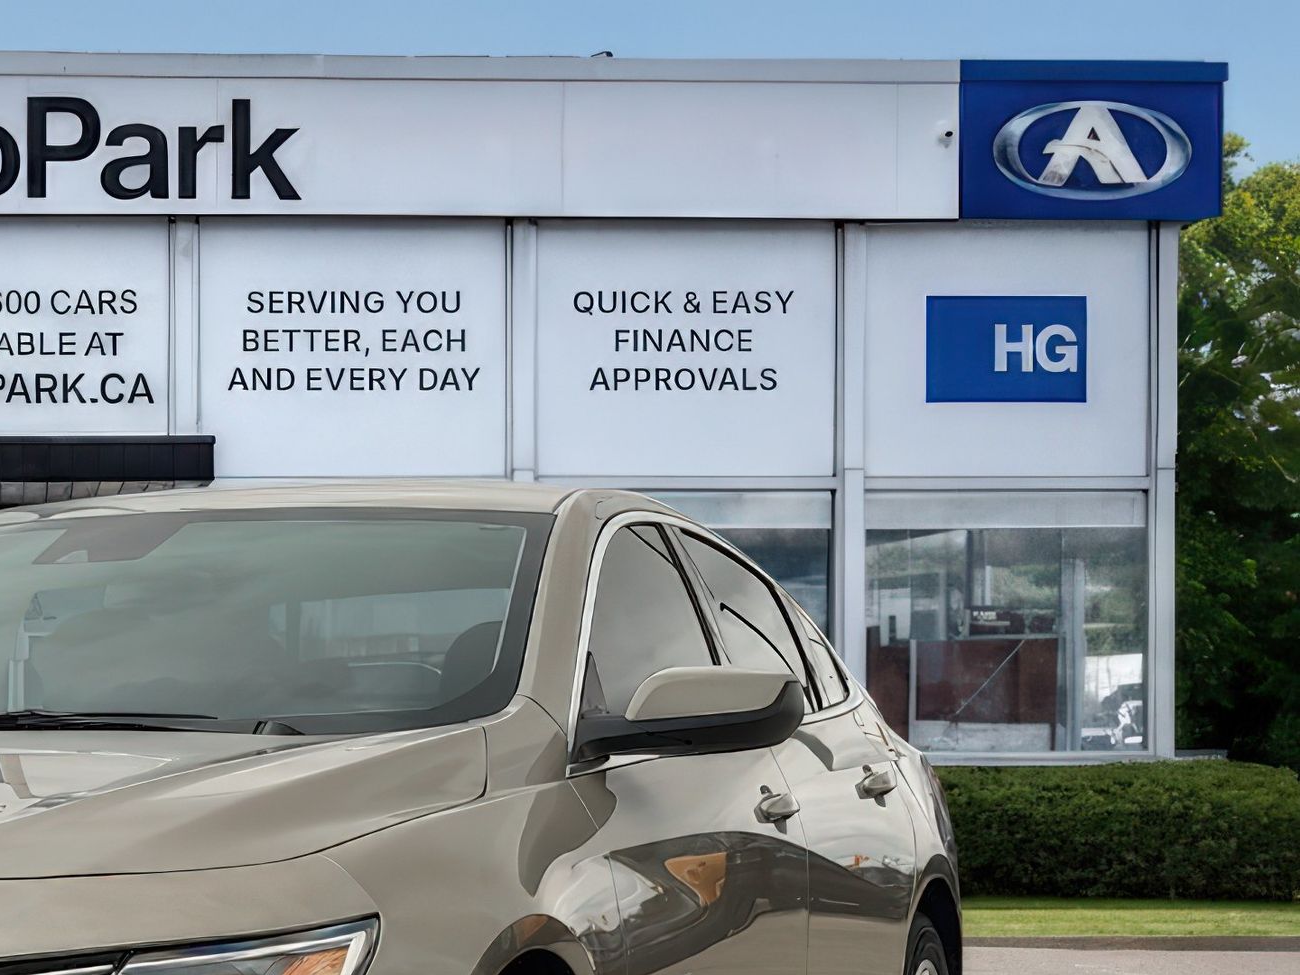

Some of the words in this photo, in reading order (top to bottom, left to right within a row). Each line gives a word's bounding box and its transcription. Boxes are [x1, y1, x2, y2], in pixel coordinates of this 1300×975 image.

[50, 288, 138, 316] CARS
[246, 290, 385, 314] SERVING
[395, 290, 461, 314] YOU
[573, 290, 673, 316] QUICK
[682, 291, 702, 314] &
[712, 290, 795, 315] EASY
[83, 331, 125, 357] AT
[242, 328, 370, 358] BETTER,
[381, 328, 466, 353] EACH
[614, 328, 753, 353] FINANCE
[993, 324, 1078, 373] HG
[227, 367, 296, 391] AND
[306, 367, 408, 391] EVERY
[418, 367, 481, 392] DAY
[589, 366, 778, 392] APPROVALS
